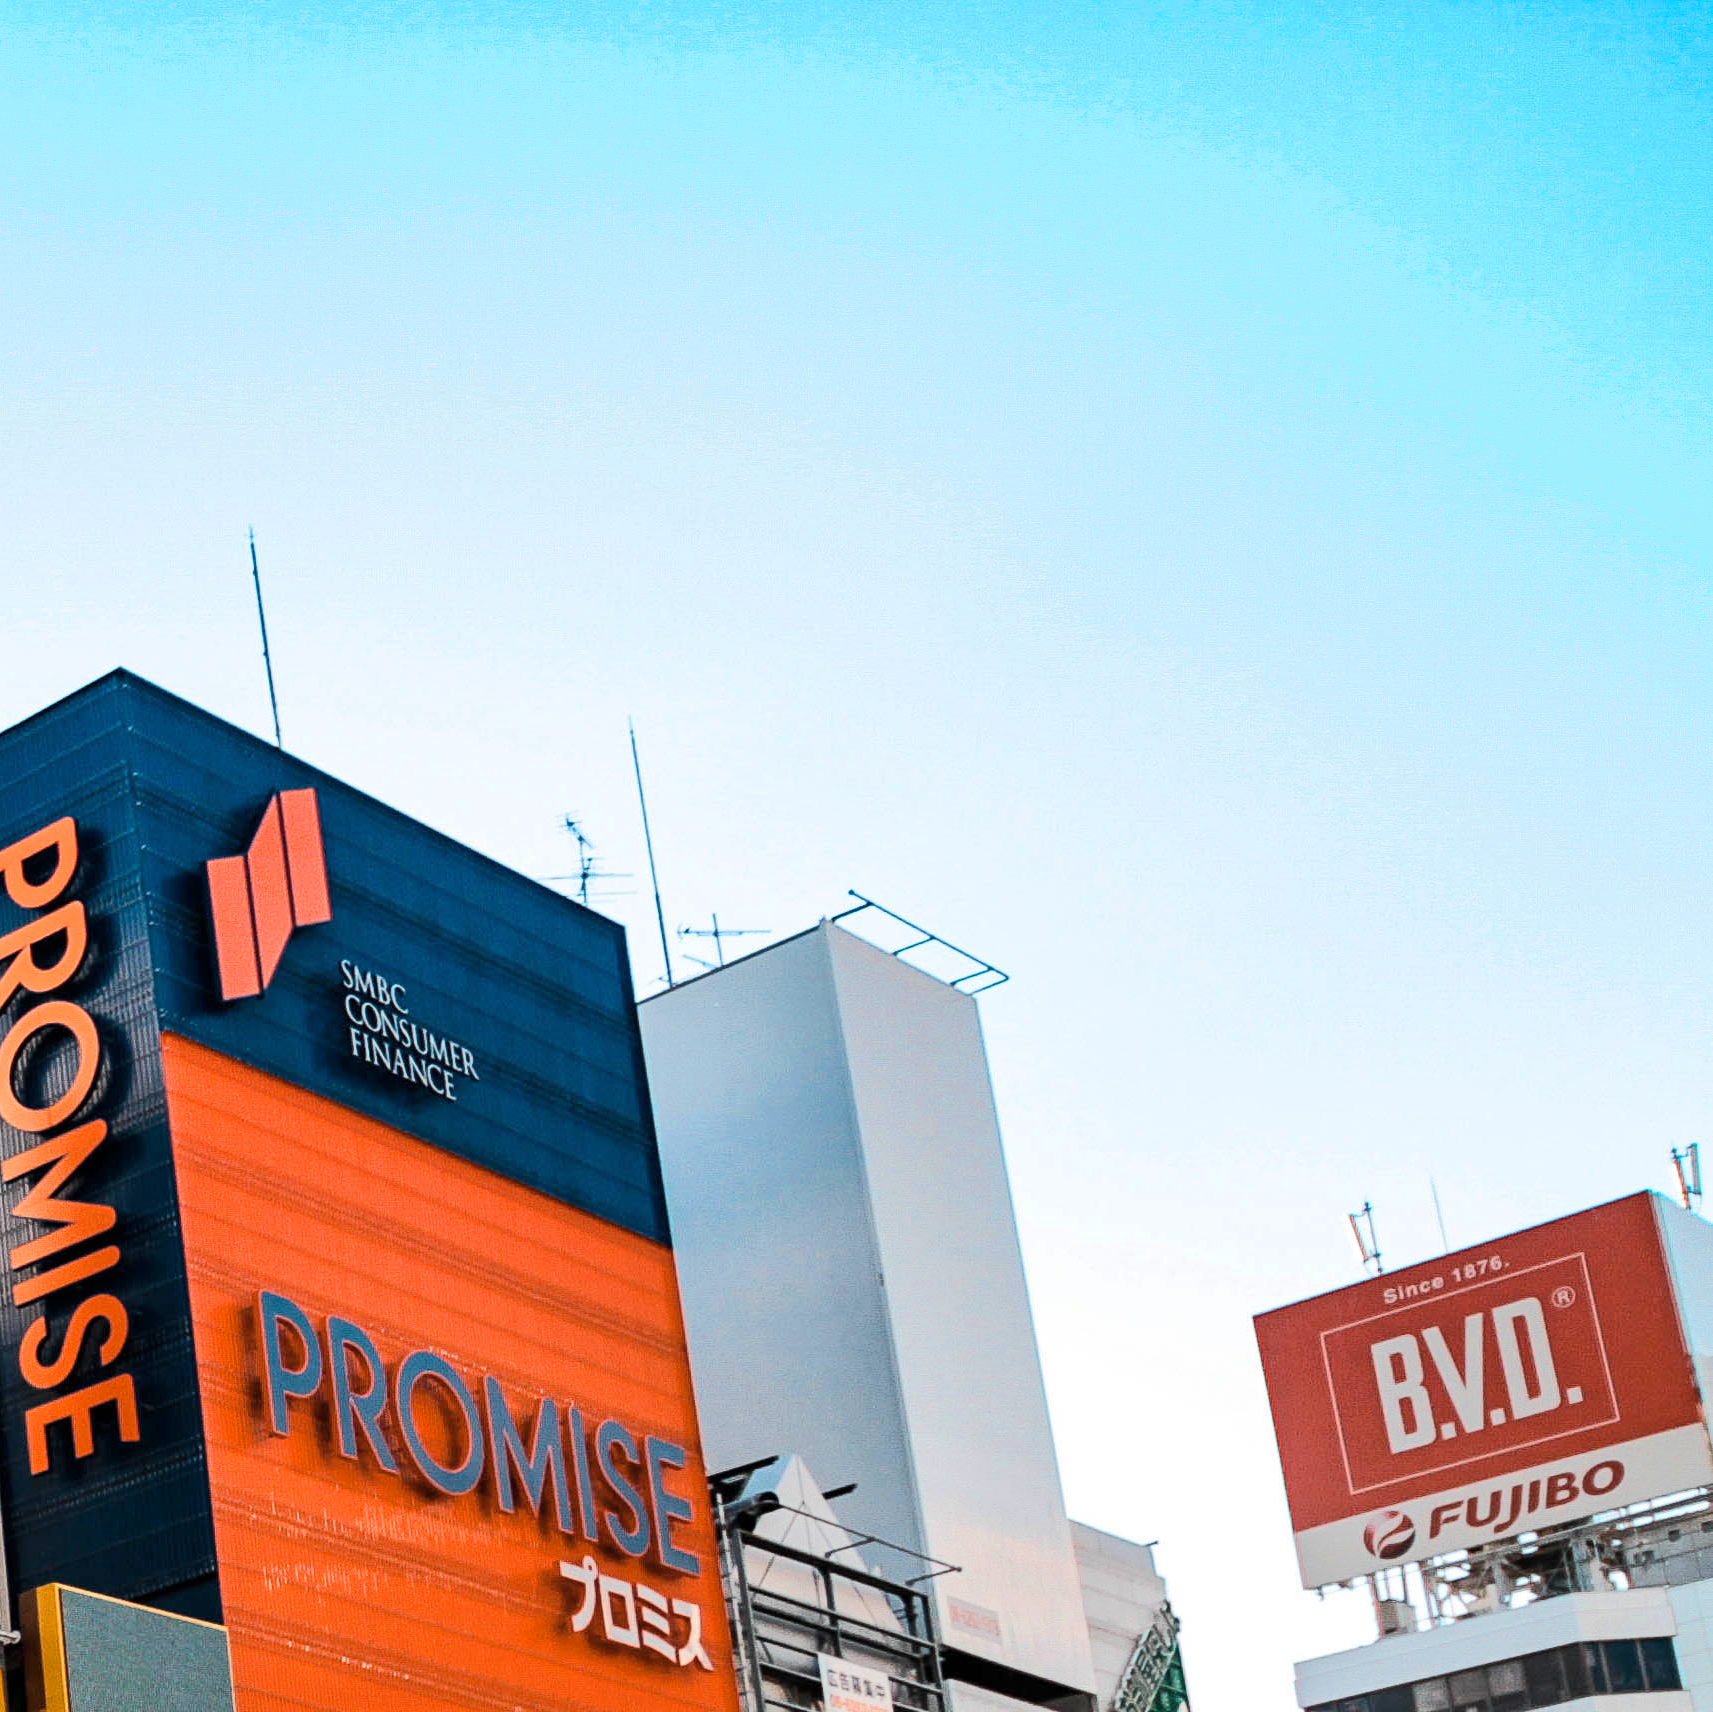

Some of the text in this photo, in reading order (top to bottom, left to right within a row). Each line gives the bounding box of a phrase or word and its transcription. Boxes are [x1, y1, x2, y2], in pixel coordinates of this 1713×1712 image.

[340, 958, 409, 1018] SMBC
[344, 993, 480, 1082] CONSUMER
[349, 1027, 457, 1103] FINANCE
[1382, 1255, 1511, 1305] Since 1876.
[1370, 1296, 1585, 1457] B.V.D.
[257, 1290, 701, 1578] PROMISE
[1428, 1459, 1627, 1540] FUJIBO
[559, 1553, 715, 1673] プロミス
